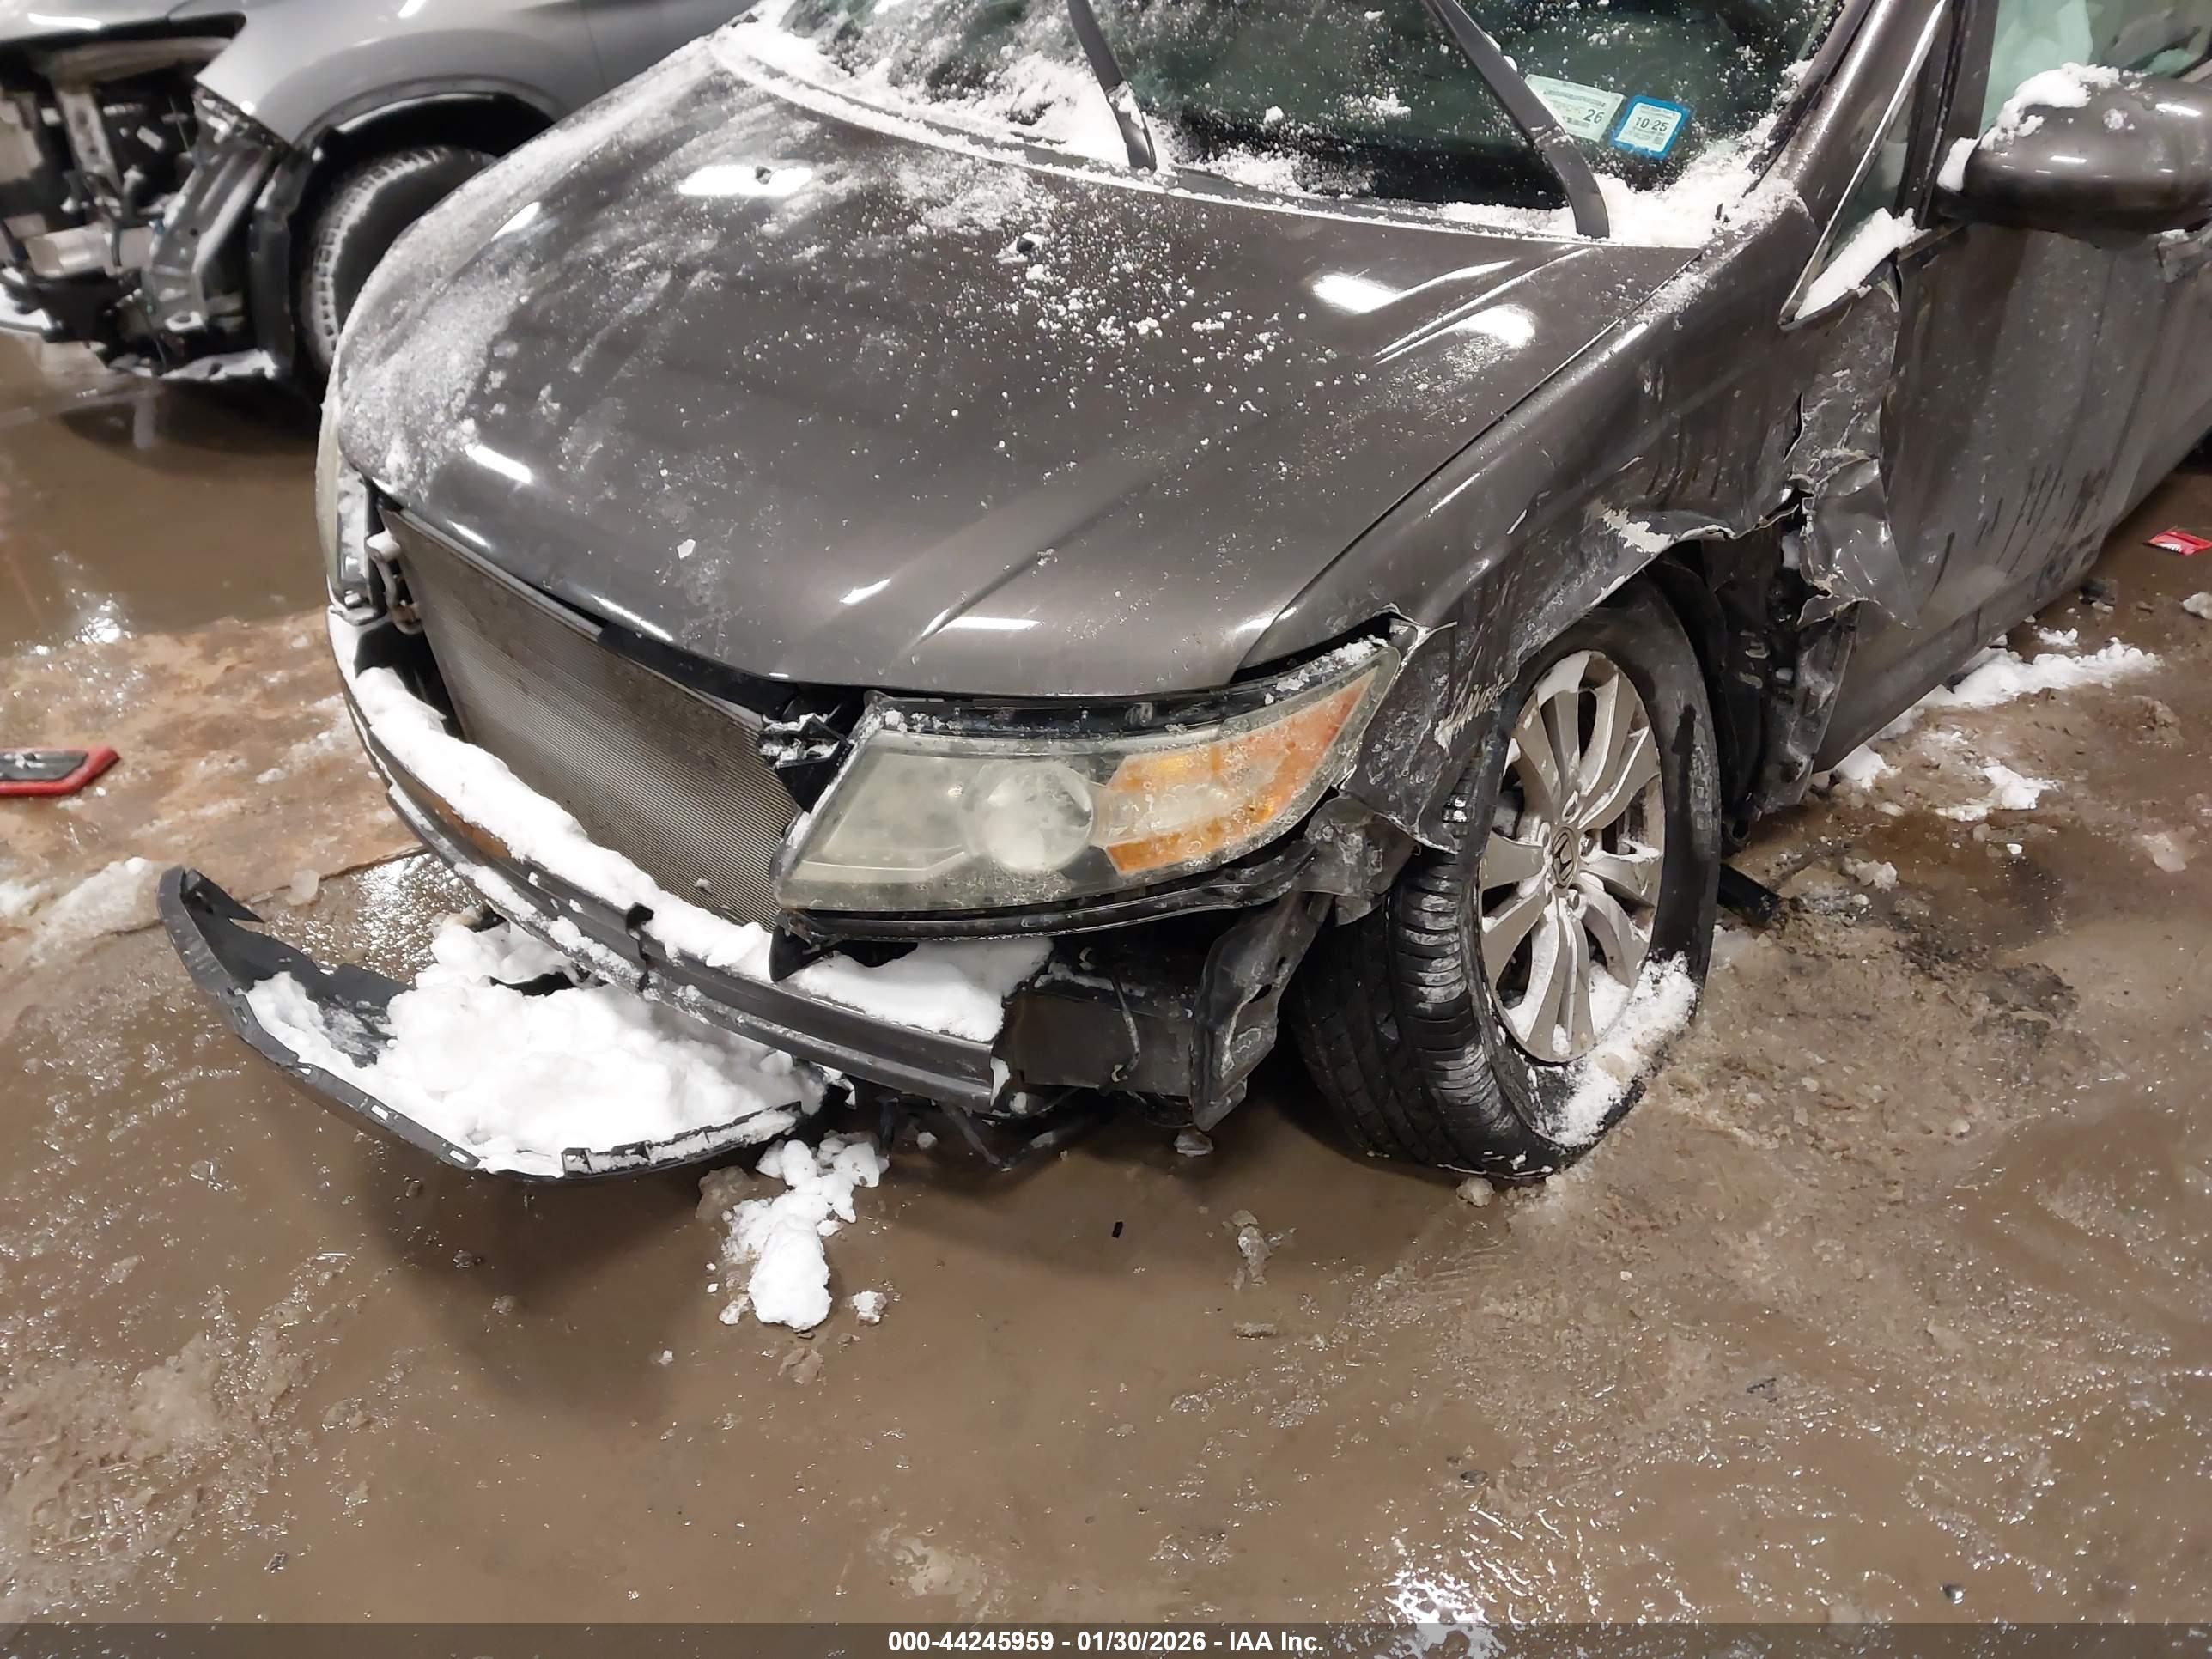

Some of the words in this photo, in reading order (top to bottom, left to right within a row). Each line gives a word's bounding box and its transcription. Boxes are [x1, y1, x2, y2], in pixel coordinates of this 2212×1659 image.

[1583, 108, 1605, 124] 26
[1635, 117, 1650, 129] 10
[1651, 119, 1670, 132] 25
